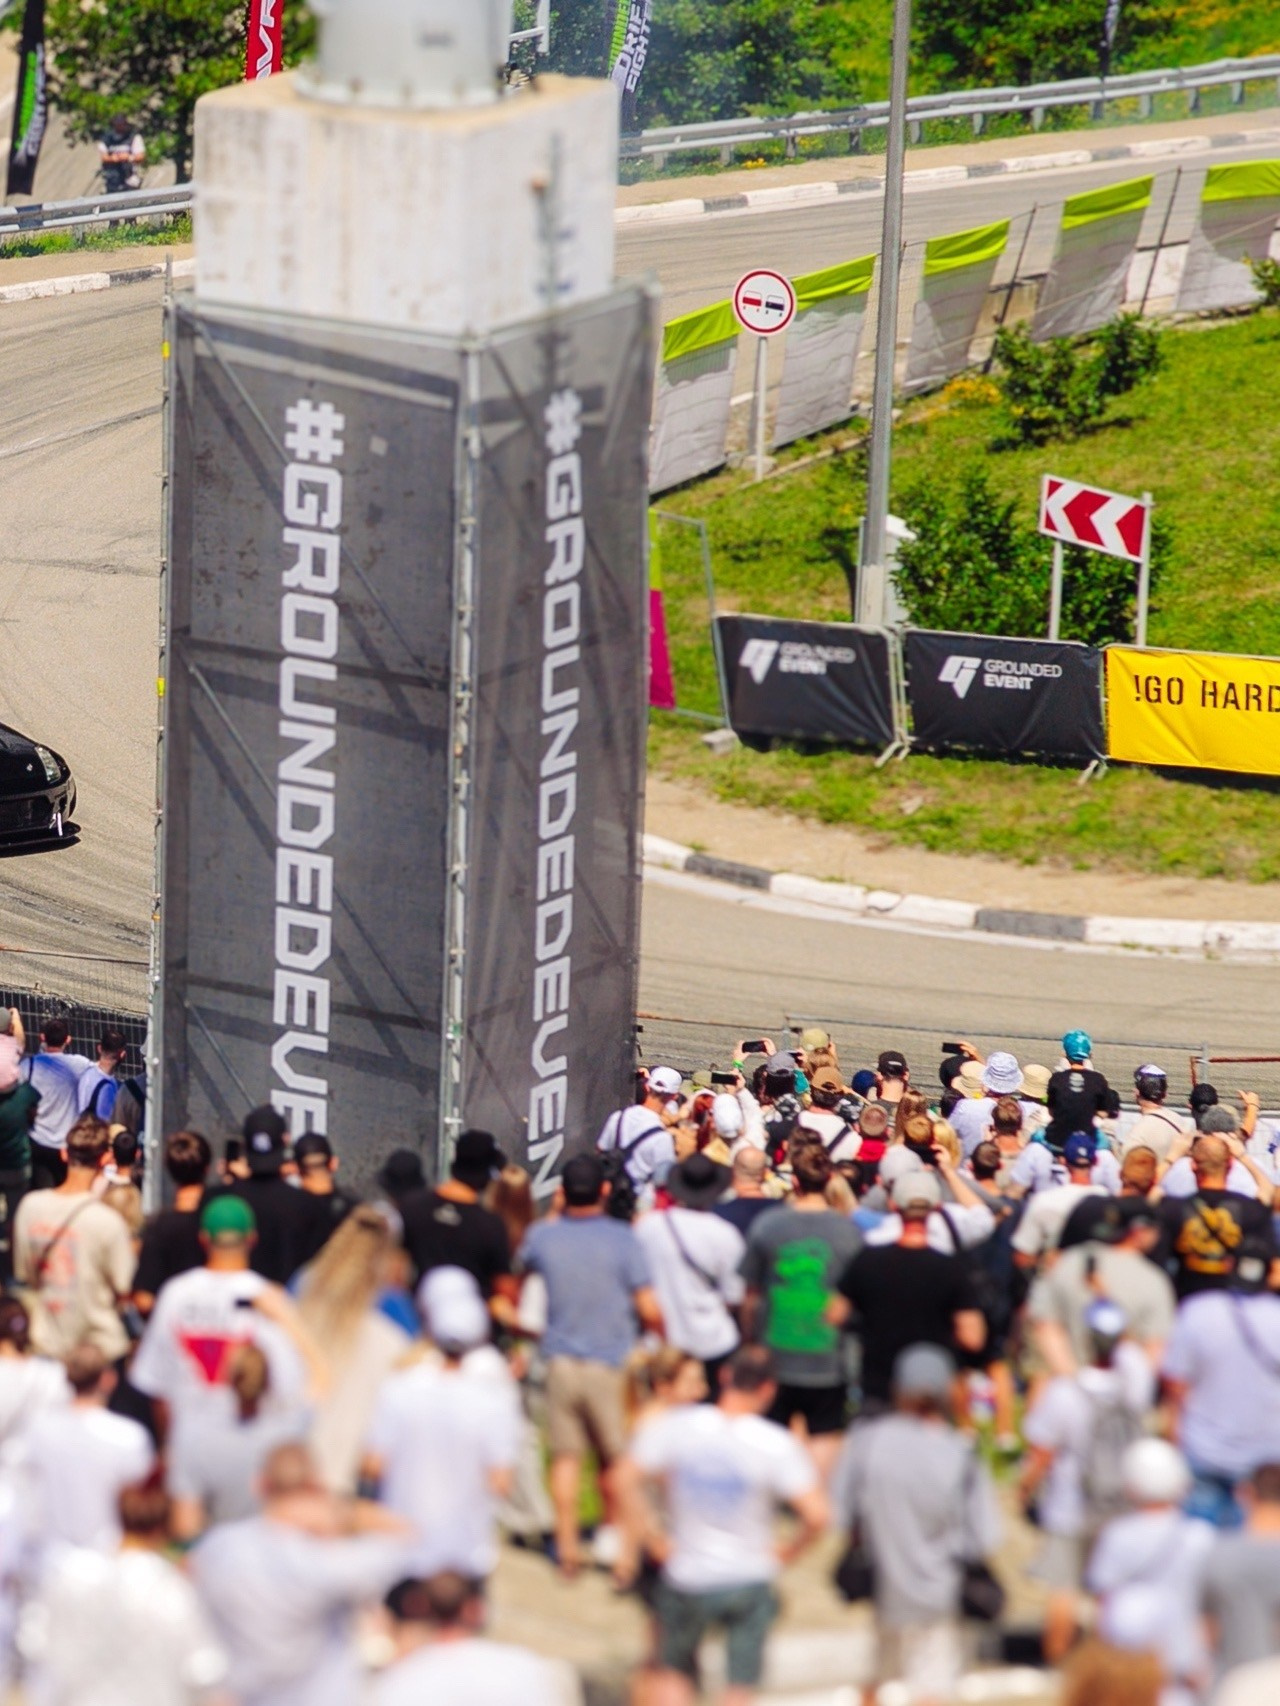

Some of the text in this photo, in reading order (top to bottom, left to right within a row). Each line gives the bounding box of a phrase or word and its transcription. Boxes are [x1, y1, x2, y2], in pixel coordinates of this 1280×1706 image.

[612, 0, 643, 87] DRIF
[780, 641, 856, 664] GROUNDED
[778, 658, 827, 675] EVENT
[984, 658, 1063, 682] GROUNDED
[984, 675, 1034, 691] EVENT
[1134, 674, 1184, 705] !GO
